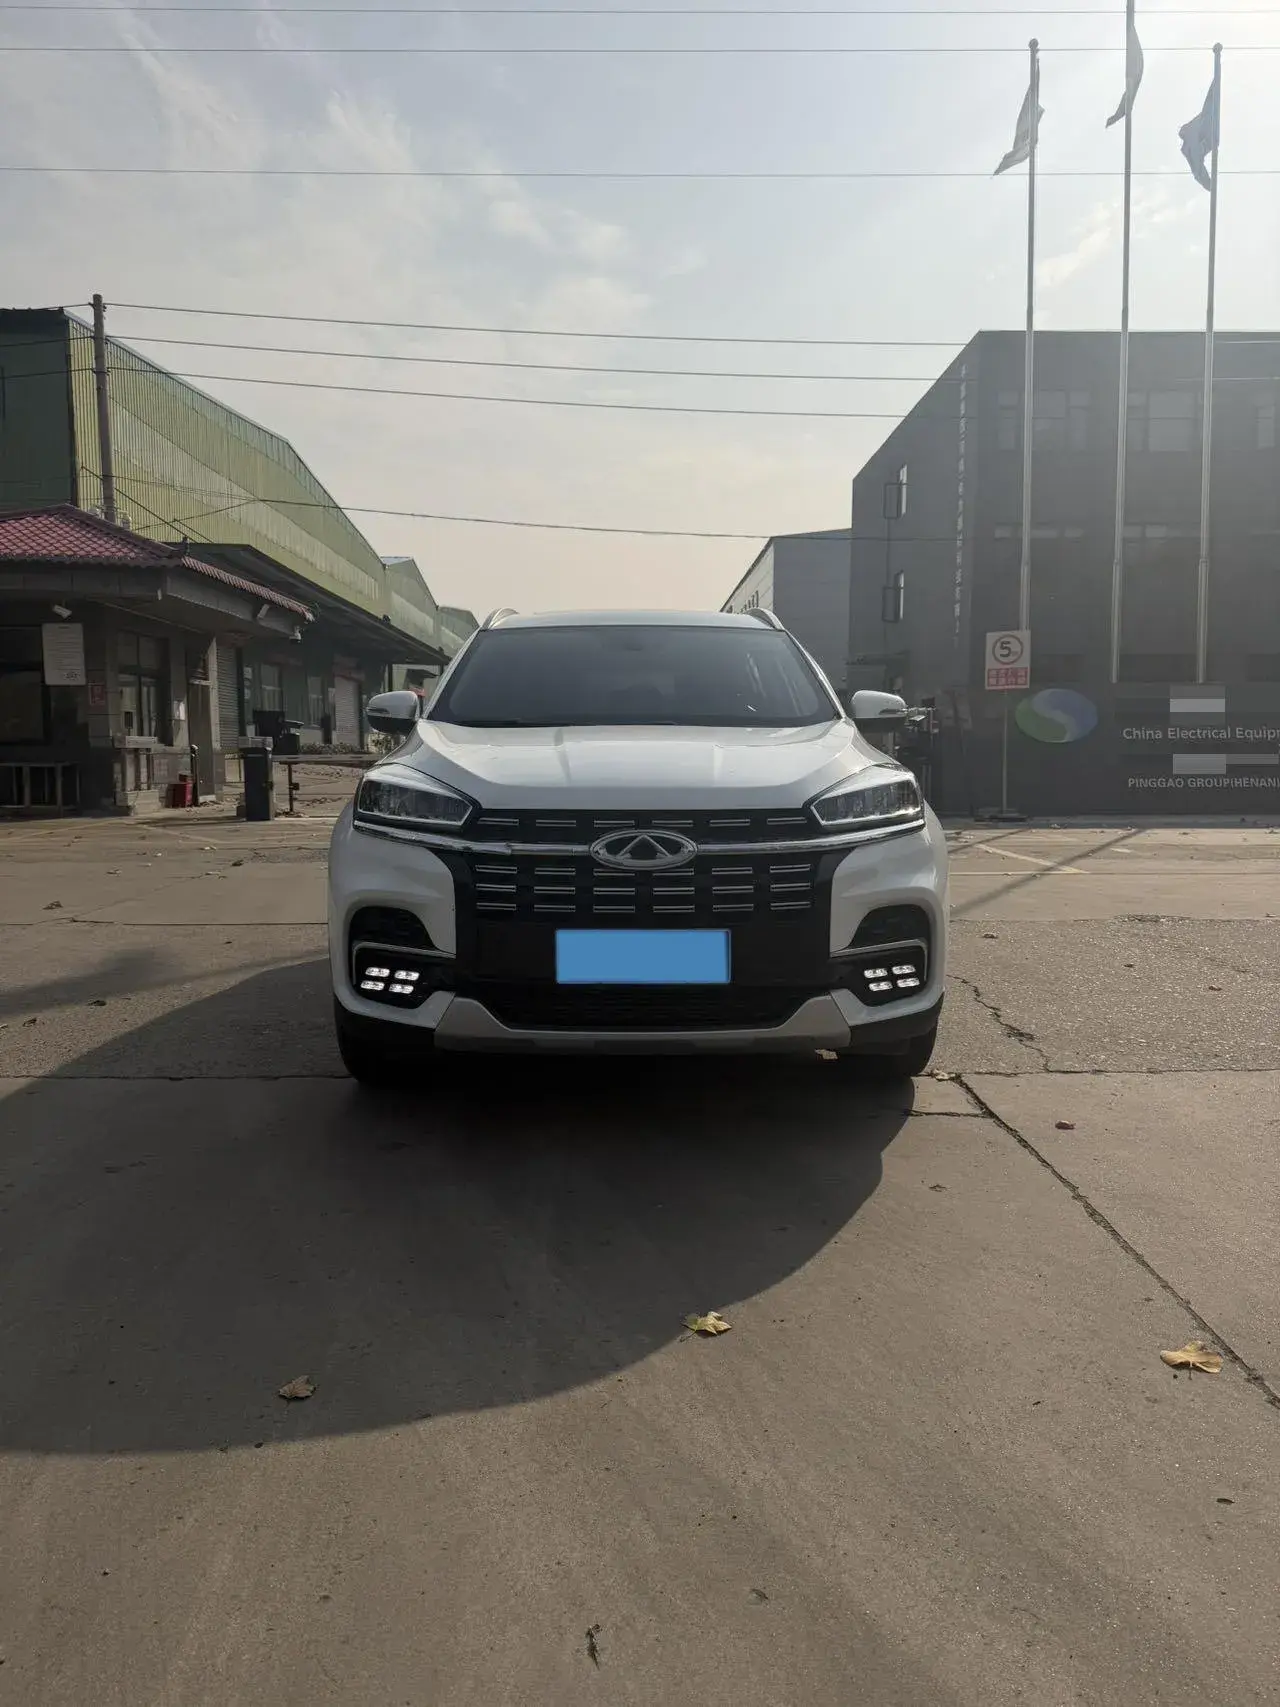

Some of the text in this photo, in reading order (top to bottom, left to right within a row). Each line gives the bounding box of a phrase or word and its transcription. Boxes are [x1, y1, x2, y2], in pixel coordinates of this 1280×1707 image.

[1122, 725, 1280, 742] China Electrical Equip
[1127, 777, 1184, 788] PINGGAO
